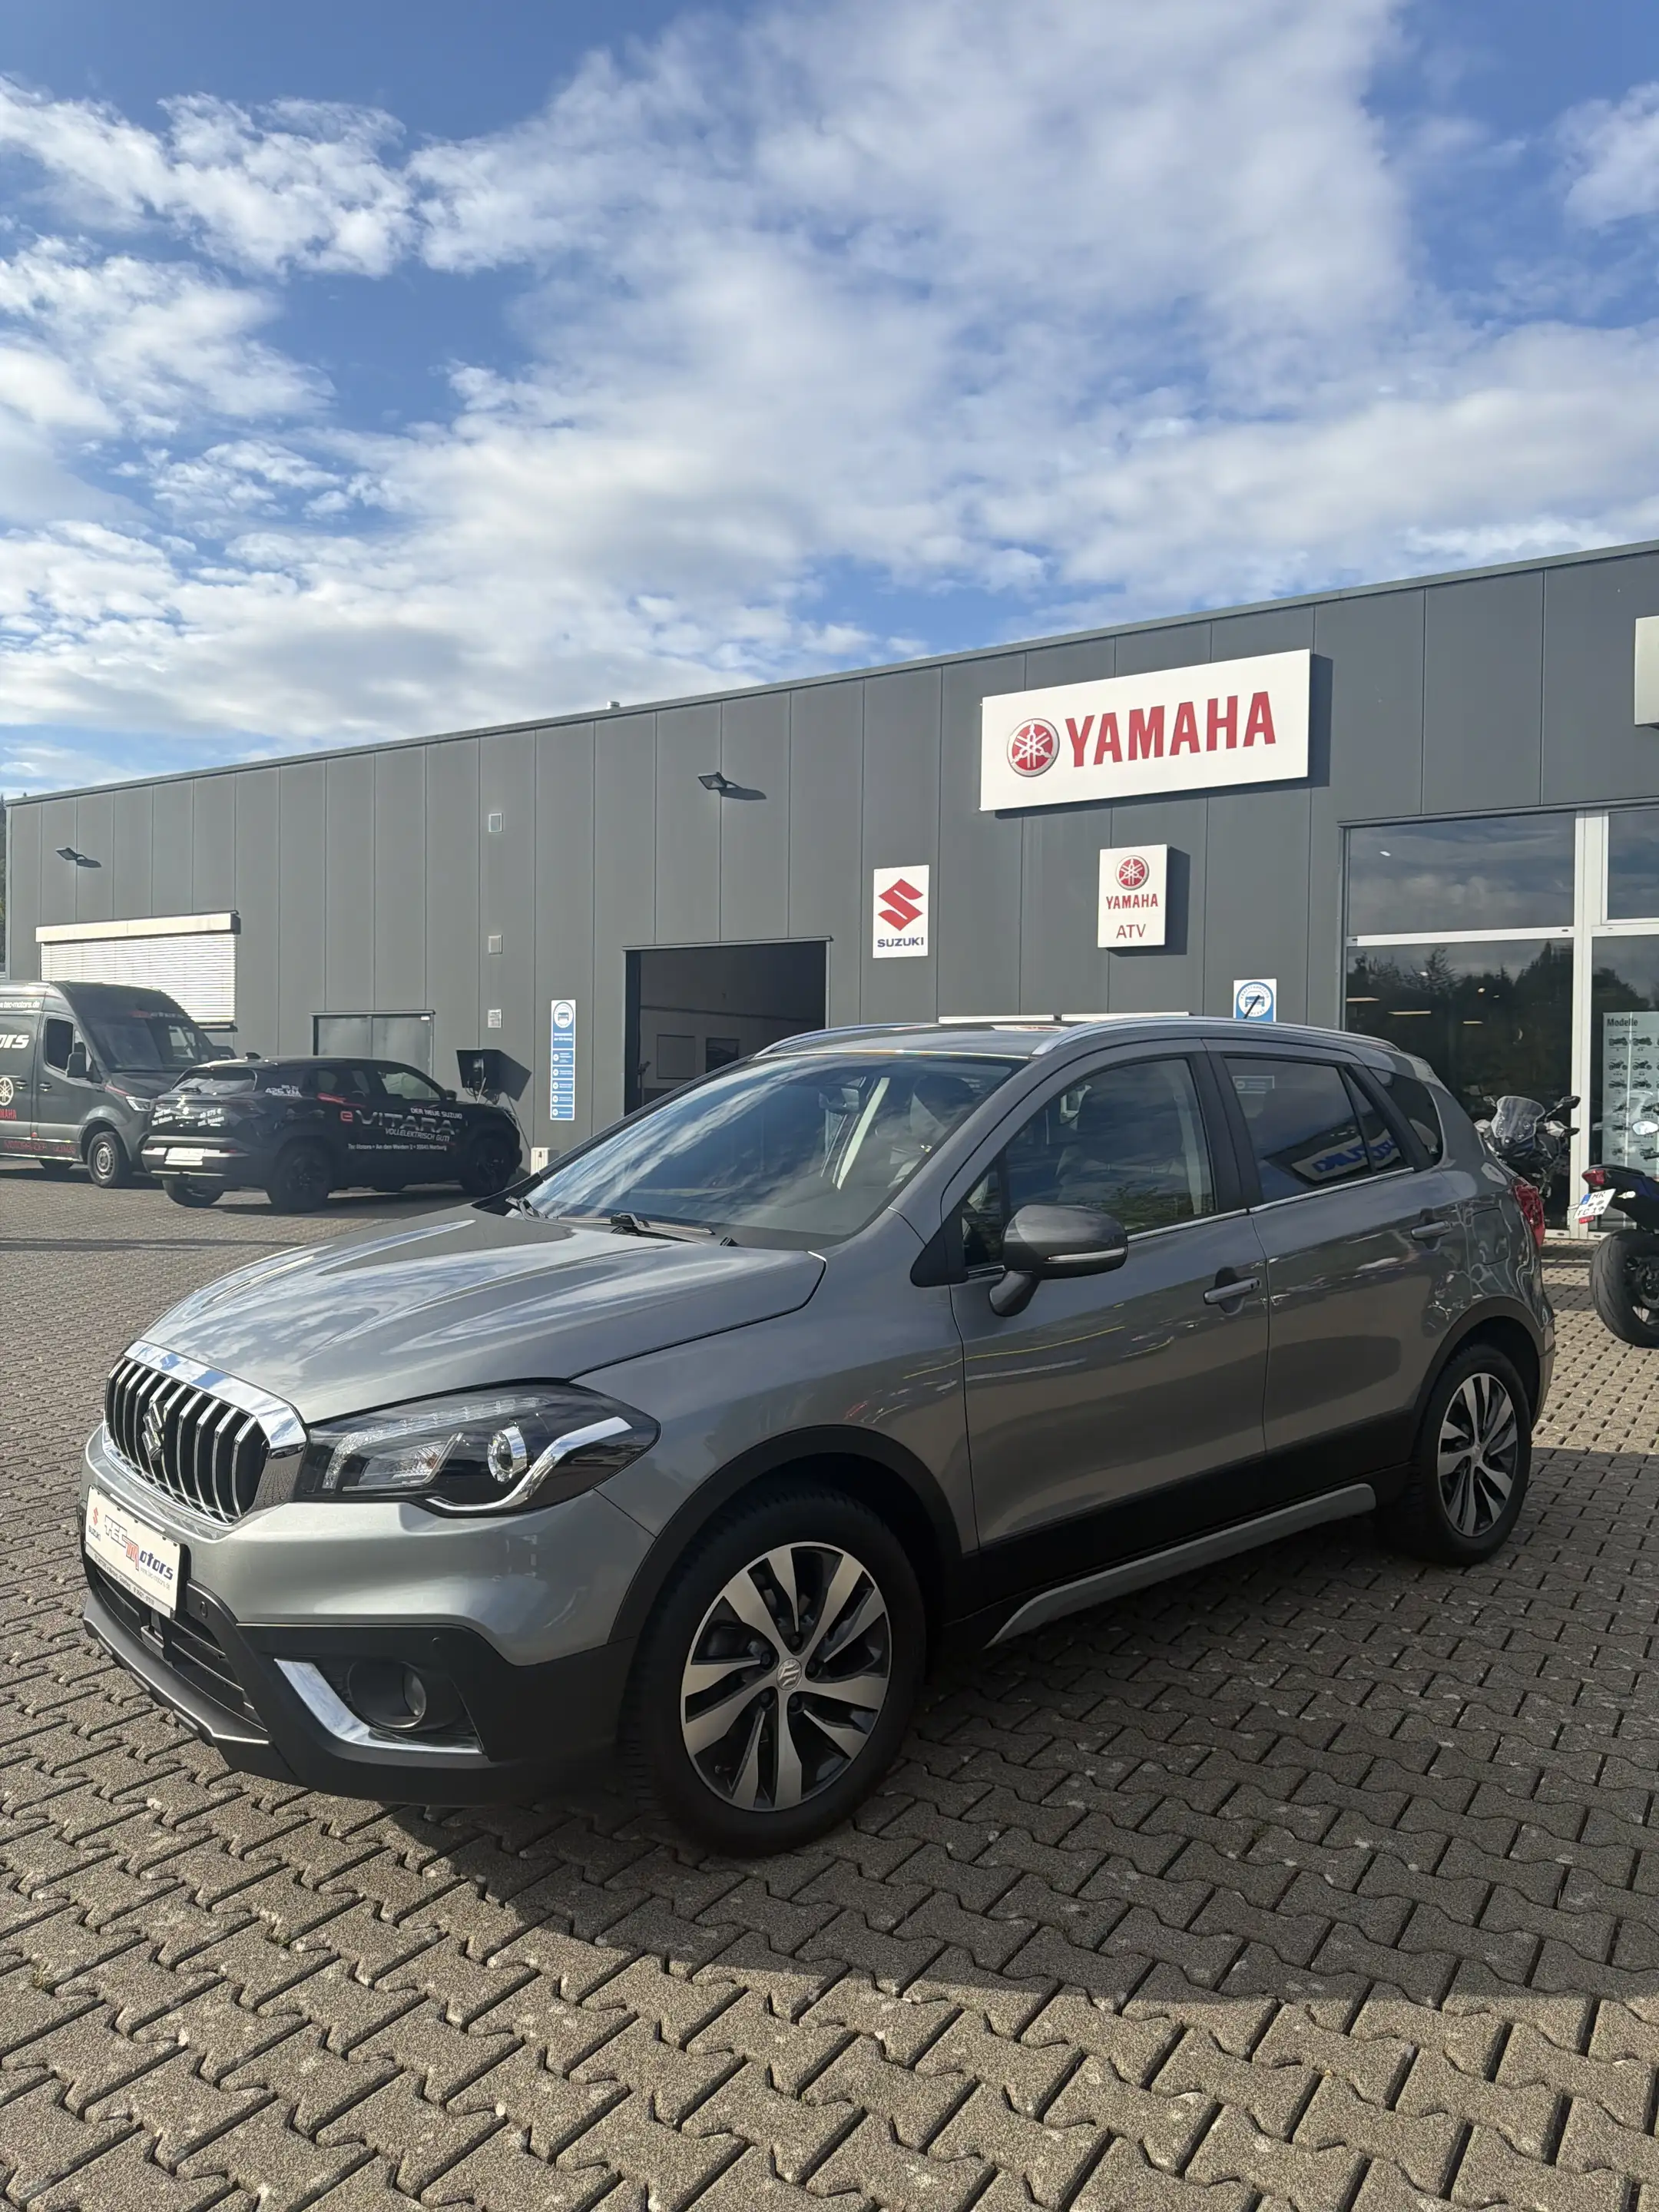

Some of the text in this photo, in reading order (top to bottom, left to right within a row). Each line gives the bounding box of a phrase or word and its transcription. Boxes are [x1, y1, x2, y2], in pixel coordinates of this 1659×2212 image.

[1065, 690, 1276, 767] YAMAHA
[1106, 893, 1158, 909] YAMAHA
[1116, 923, 1146, 939] ATV
[877, 937, 924, 947] SUZUKI
[1607, 1018, 1638, 1027] Modelle
